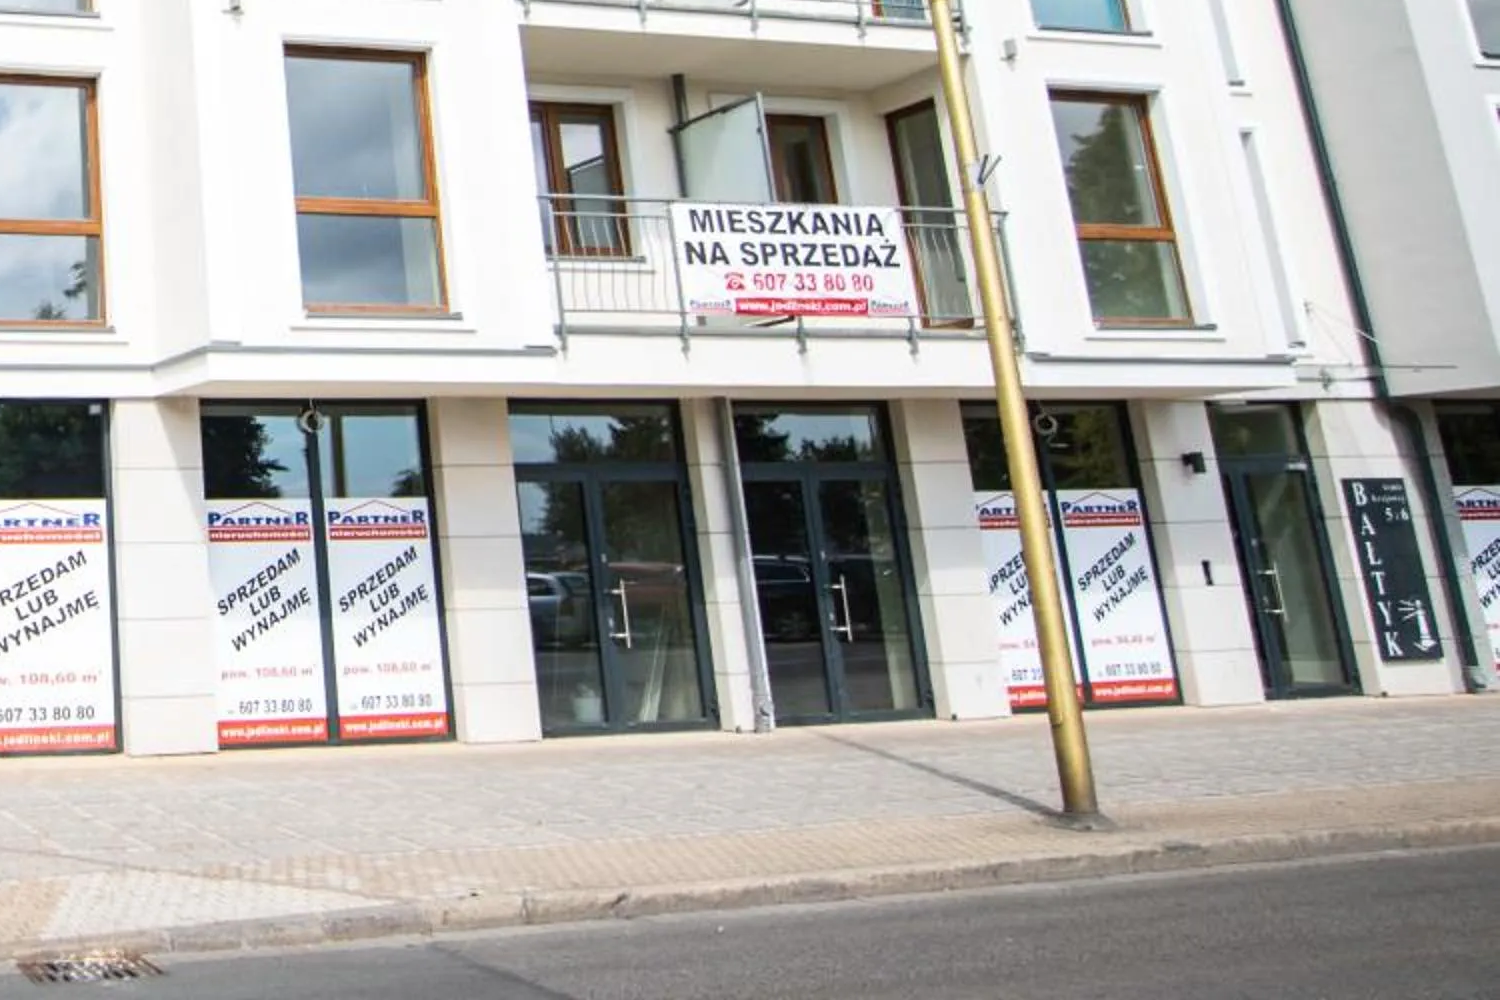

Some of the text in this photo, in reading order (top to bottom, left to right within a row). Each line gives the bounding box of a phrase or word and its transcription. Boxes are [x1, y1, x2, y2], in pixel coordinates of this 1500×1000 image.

[689, 209, 884, 237] MIESZKANIA
[685, 239, 901, 268] NA SPRZEDAŻ
[753, 273, 874, 292] 607 33 80 80
[208, 511, 309, 526] PARTNER
[328, 510, 425, 525] PARTNER
[1061, 501, 1138, 514] PARTNER
[1077, 532, 1137, 591] SPRZEDAM
[217, 548, 302, 615] SPRZEDAM
[338, 546, 418, 613] SPRZEDAM
[1101, 565, 1126, 591] LUB
[14, 588, 59, 621] LUB
[249, 587, 282, 617] LUB
[369, 583, 401, 614] LUB
[231, 587, 311, 652] WYNAJMĘ
[353, 584, 430, 648] WYNAJMĘ
[29, 707, 47, 721] 33
[52, 707, 71, 721] 80
[76, 706, 95, 720] 80
